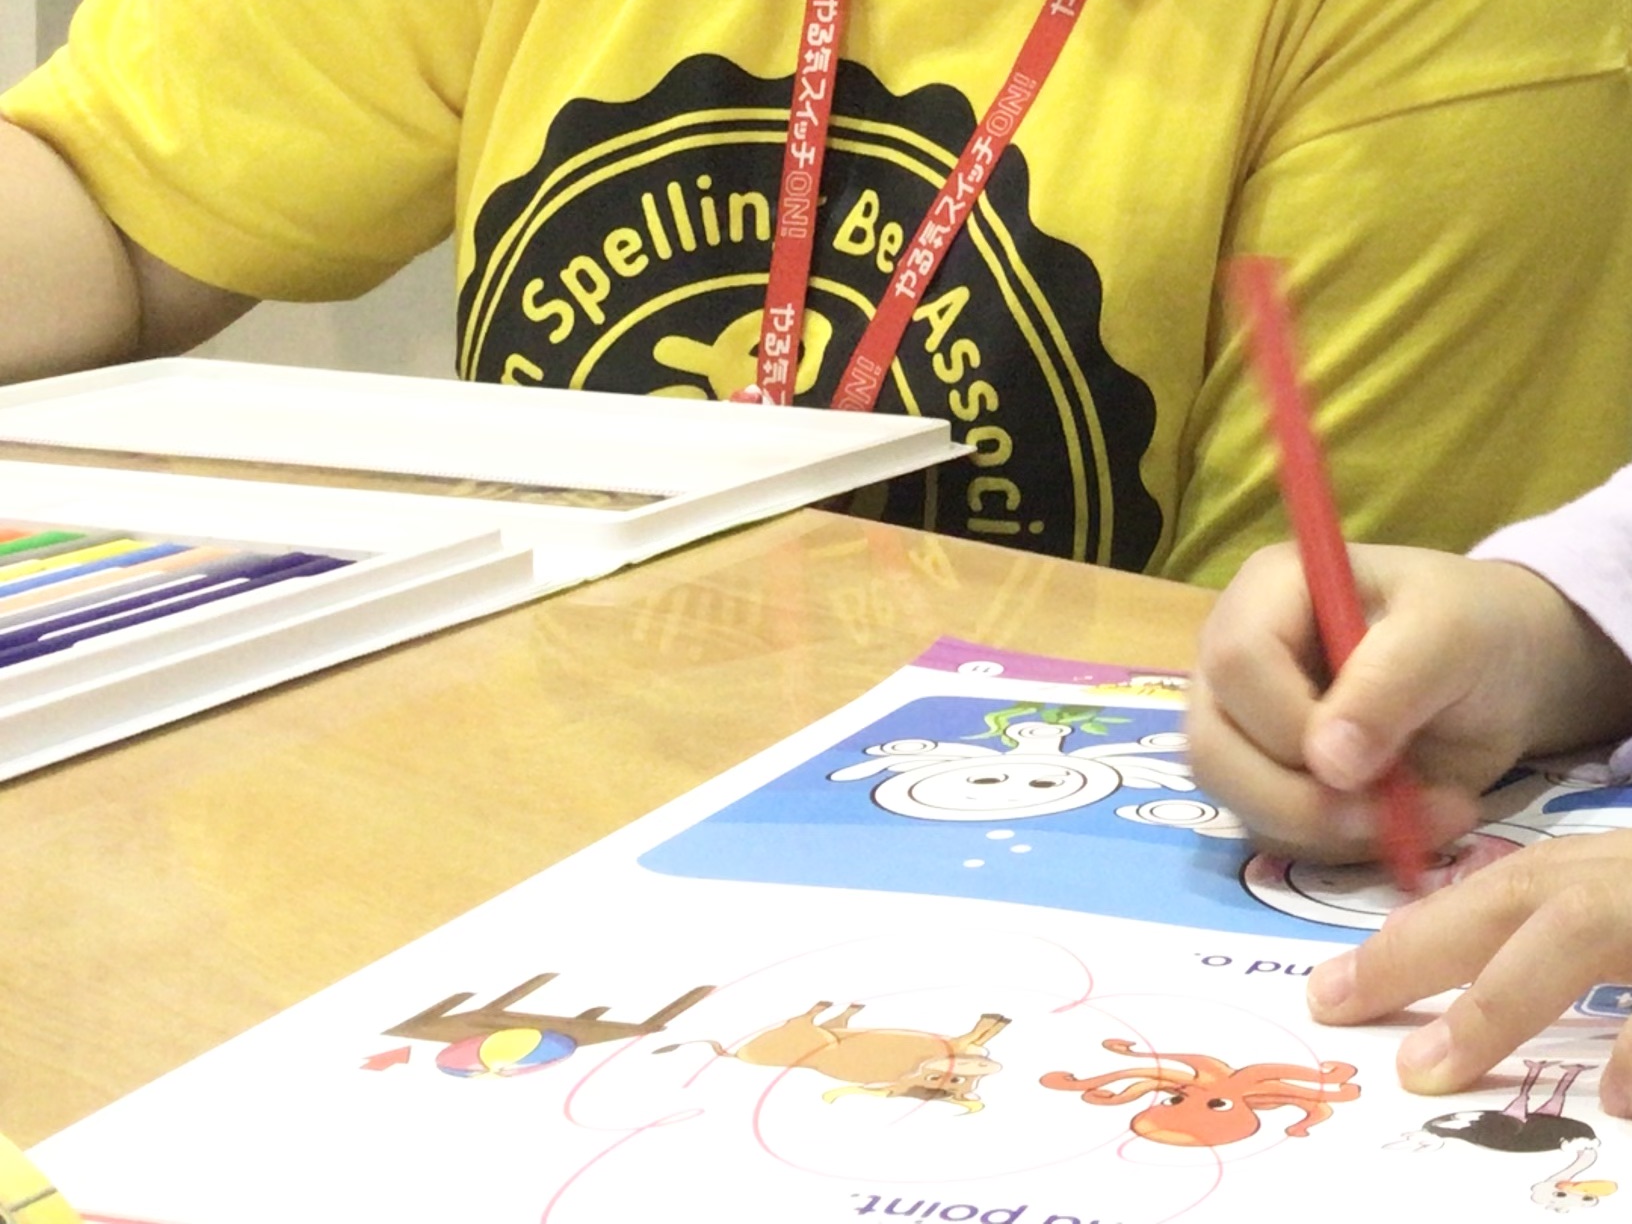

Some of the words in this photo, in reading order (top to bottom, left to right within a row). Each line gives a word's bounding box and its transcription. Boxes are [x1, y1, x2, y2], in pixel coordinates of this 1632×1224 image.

[521, 174, 774, 344] Spellin
[833, 189, 903, 273] Be
[895, 72, 1036, 298] やる気スイッチON!
[1244, 960, 1314, 976] nd
